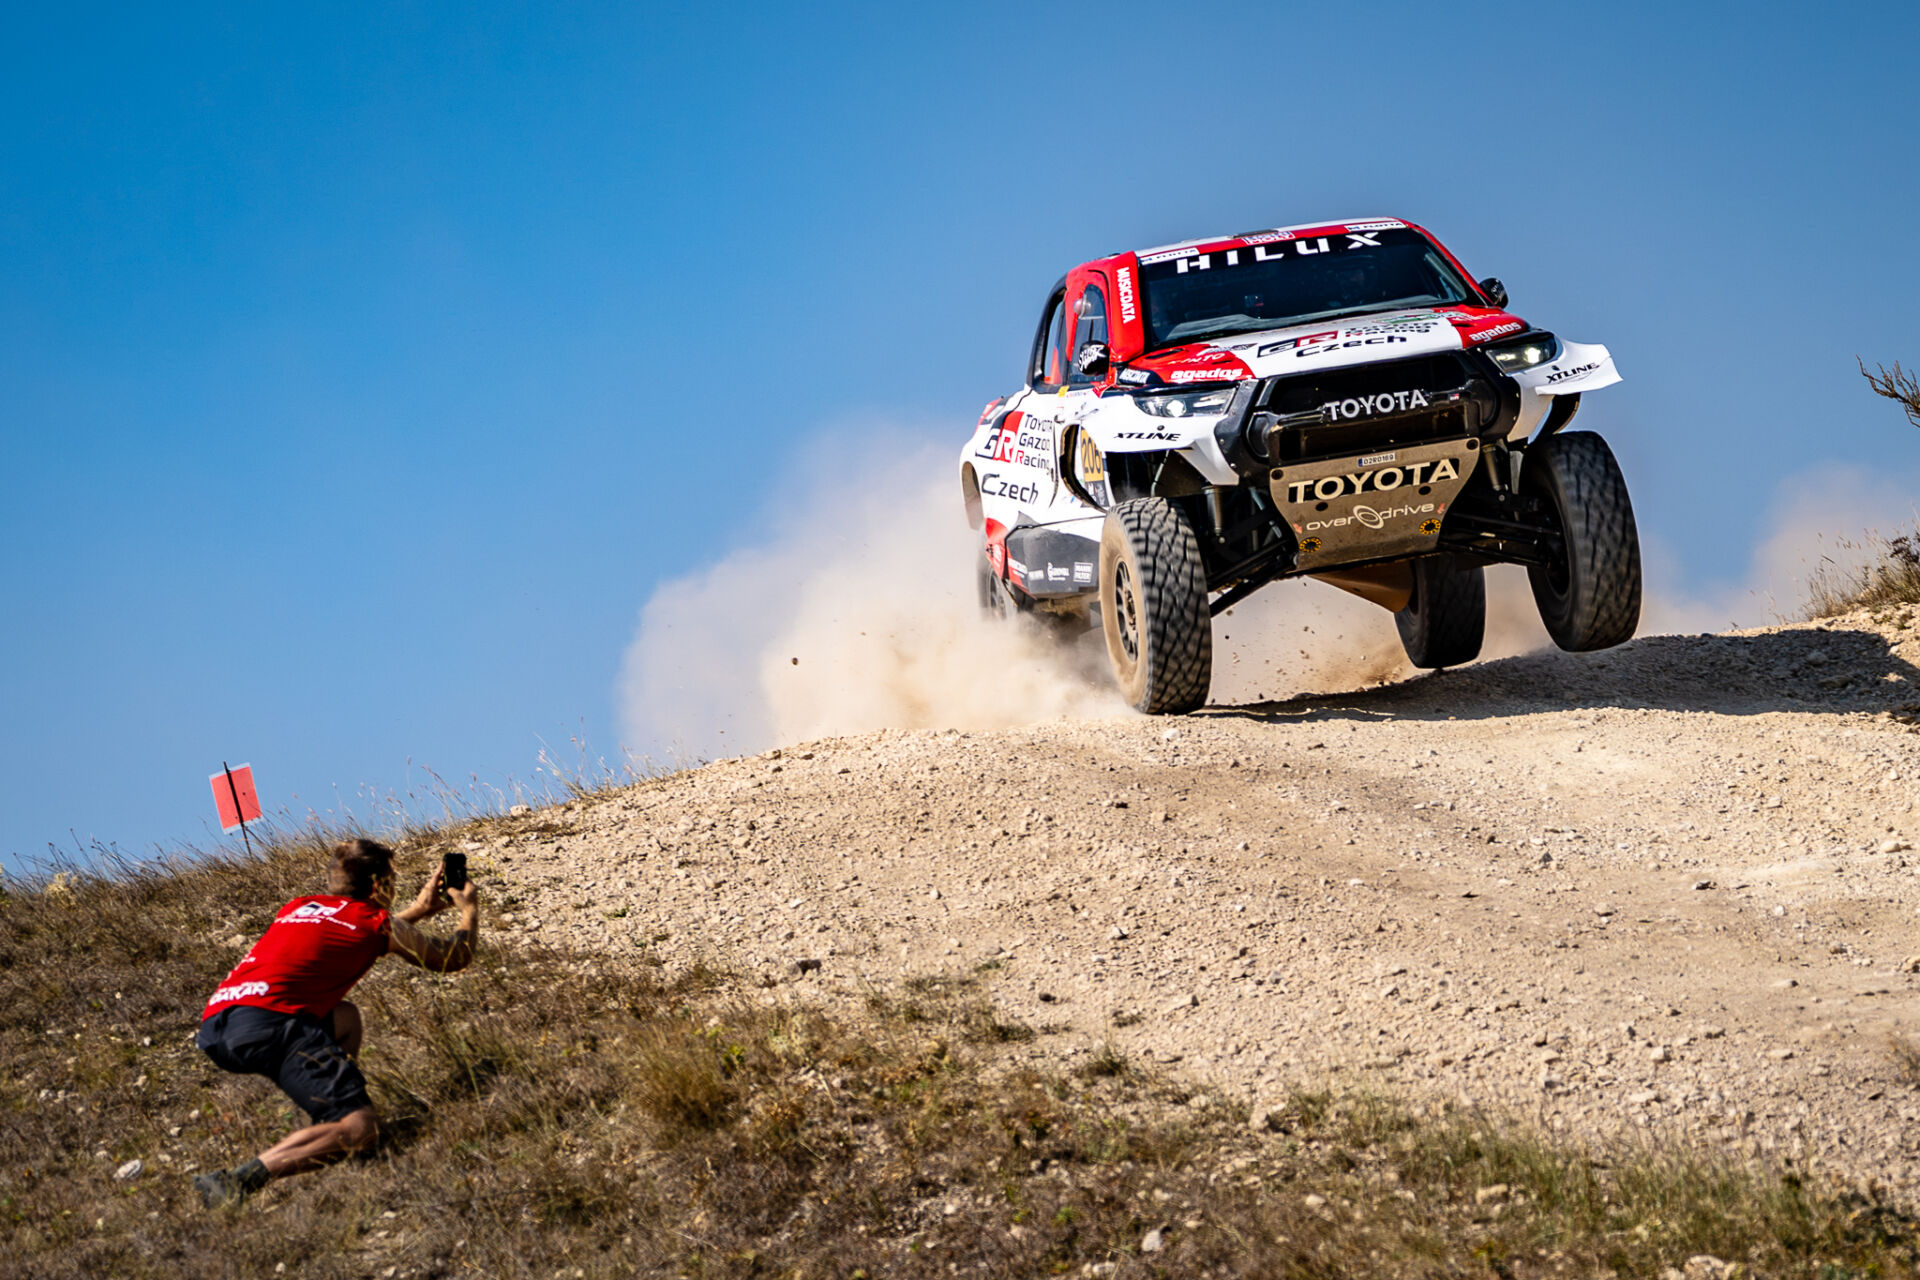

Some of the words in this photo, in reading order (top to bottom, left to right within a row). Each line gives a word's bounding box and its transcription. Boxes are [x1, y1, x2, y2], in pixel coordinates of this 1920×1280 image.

[1177, 231, 1382, 274] HILUX
[1116, 266, 1136, 324] MUSICDATA
[1257, 330, 1339, 358] GR
[1296, 335, 1407, 358] Czech
[1469, 321, 1522, 343] agados
[1170, 367, 1244, 383] agados
[1546, 362, 1600, 383] XTLINE
[1326, 389, 1429, 421] TOYOTA
[975, 427, 1019, 463] GR
[1114, 432, 1182, 442] XTLINE
[1014, 450, 1050, 476] Racing
[1081, 437, 1101, 474] 206
[981, 473, 1039, 505] Czech
[1288, 458, 1459, 504] TOYOTA
